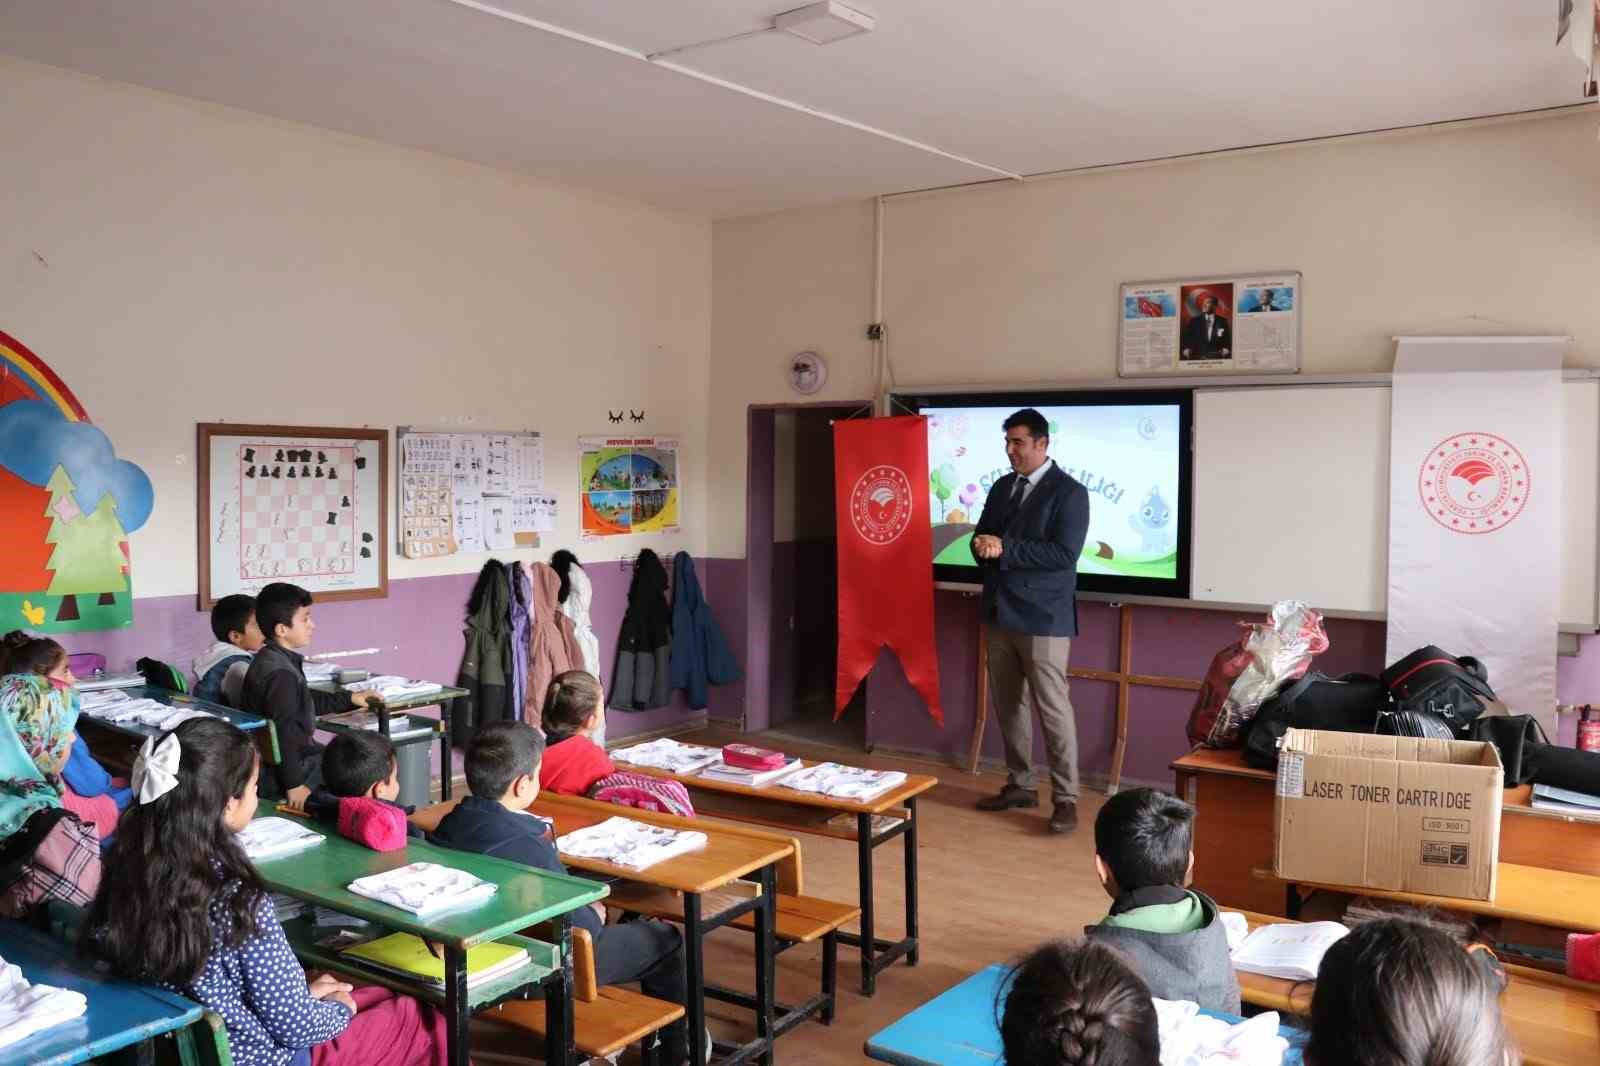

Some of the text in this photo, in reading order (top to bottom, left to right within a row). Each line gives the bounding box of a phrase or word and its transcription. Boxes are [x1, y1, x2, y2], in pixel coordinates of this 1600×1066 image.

[1303, 780, 1472, 810] LASER TONER CARTRIDGE
